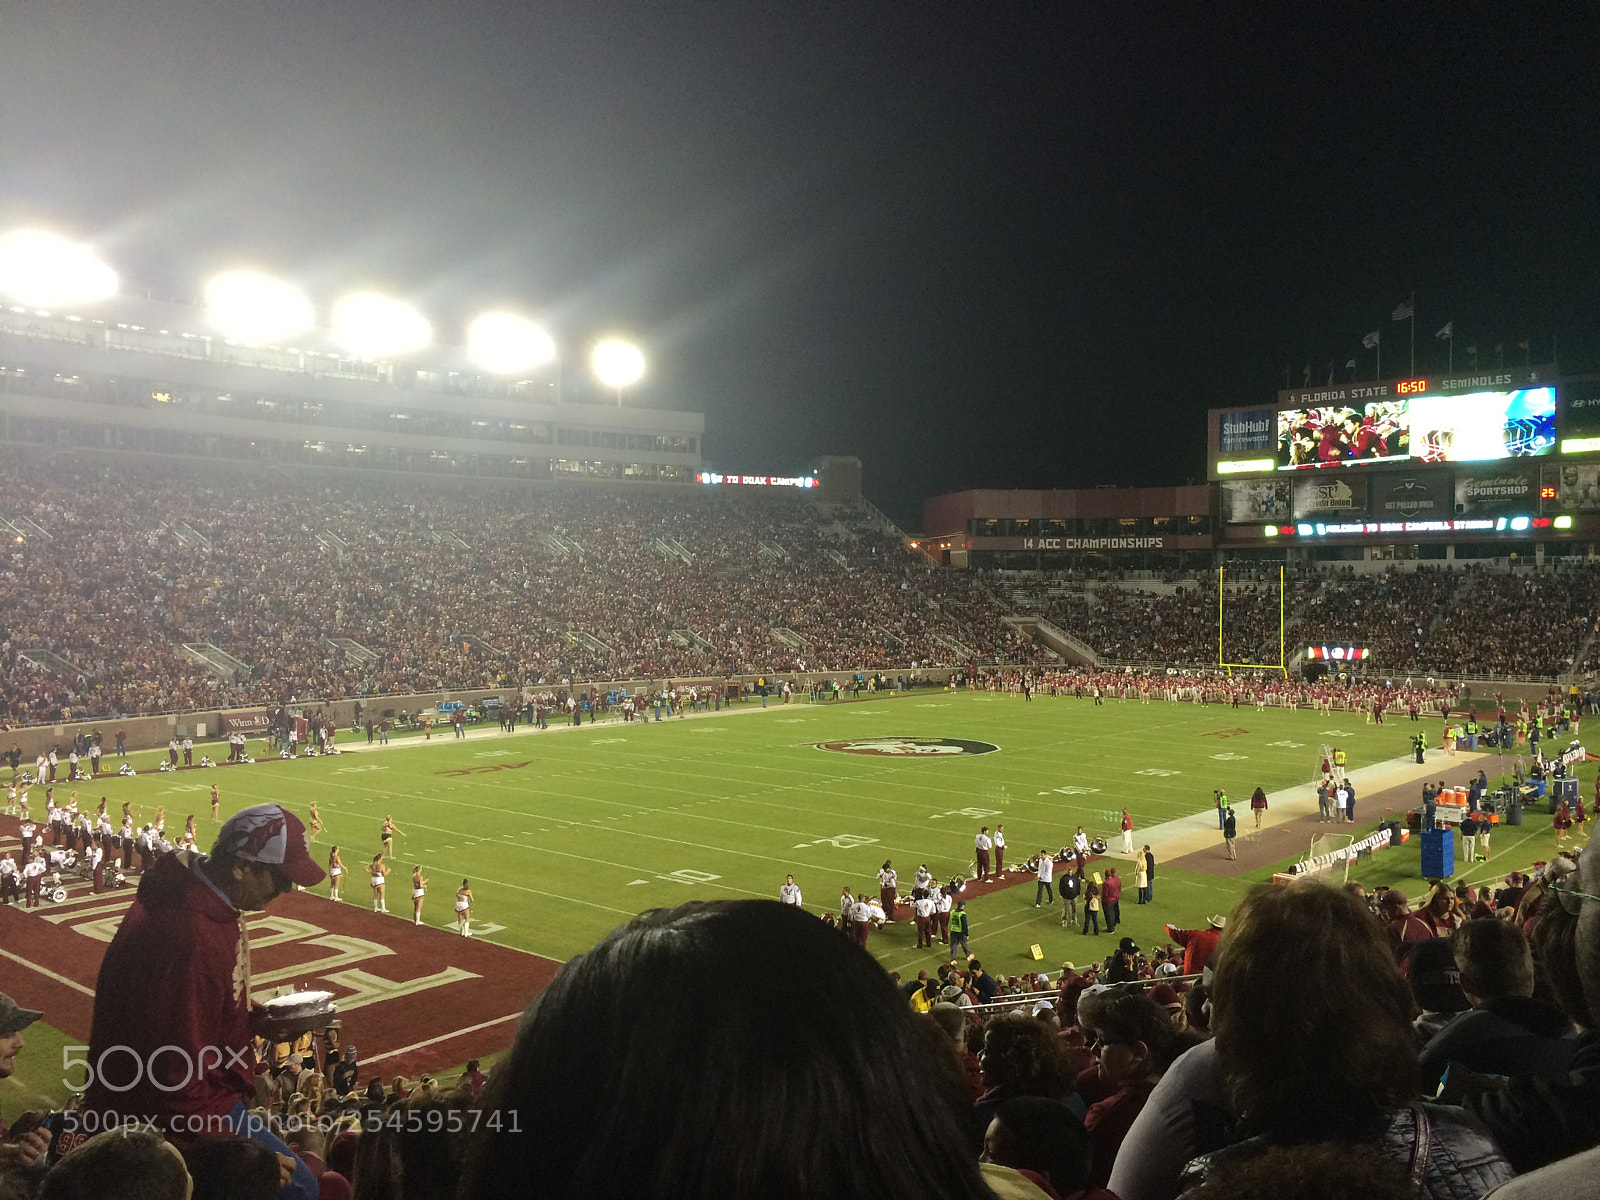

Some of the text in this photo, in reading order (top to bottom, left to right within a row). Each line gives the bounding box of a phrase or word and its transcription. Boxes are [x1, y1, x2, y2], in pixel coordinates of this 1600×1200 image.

[1397, 380, 1426, 393] 16:50
[1442, 374, 1512, 390] SEMINOLES
[1301, 386, 1388, 403] FLORIDA STATE
[1223, 419, 1270, 435] StubHub!
[1463, 475, 1529, 488] Seminole
[1467, 485, 1529, 496] SPORTSHOP
[1541, 487, 1555, 498] 25
[1023, 537, 1163, 549] 14 ACC CHAMPIONSHIPS
[228, 718, 253, 728] Winn
